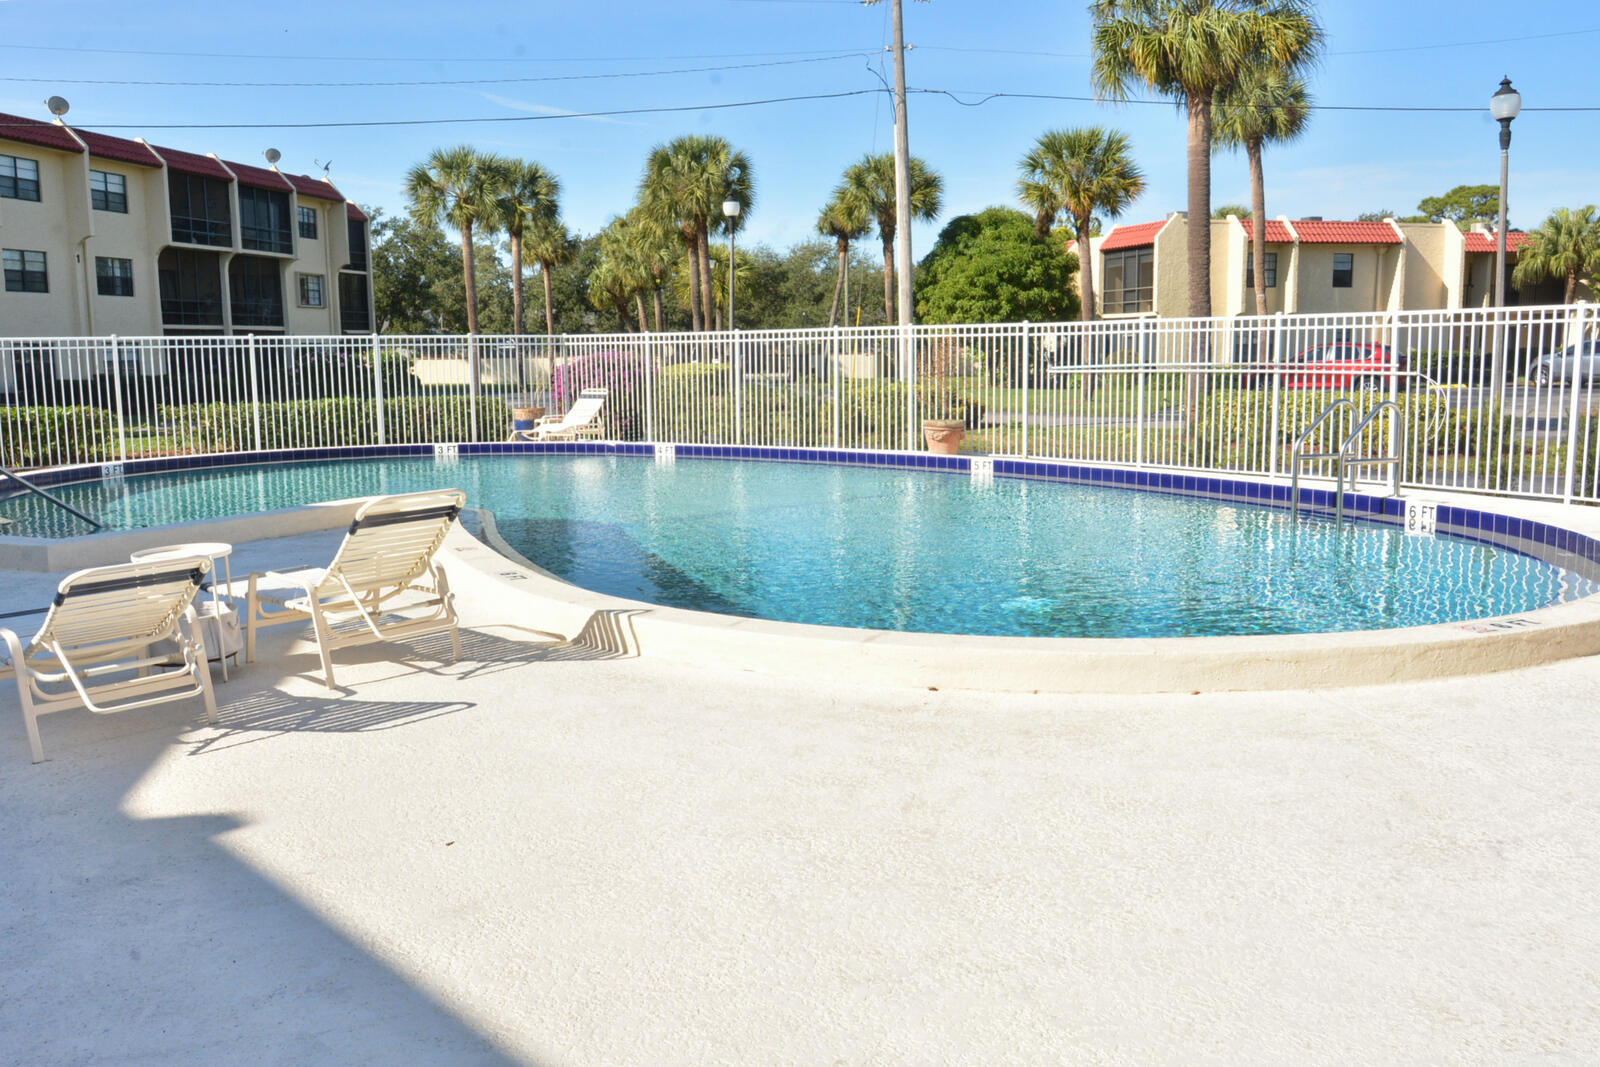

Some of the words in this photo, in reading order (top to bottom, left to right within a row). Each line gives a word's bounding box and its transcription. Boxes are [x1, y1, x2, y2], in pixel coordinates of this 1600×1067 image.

[447, 445, 457, 454] FT
[665, 446, 673, 454] FT
[105, 466, 110, 475] 3
[113, 465, 122, 473] FT
[974, 461, 979, 470] 5
[983, 461, 992, 470] FT
[1410, 505, 1416, 518] 6
[1422, 505, 1435, 520] FT
